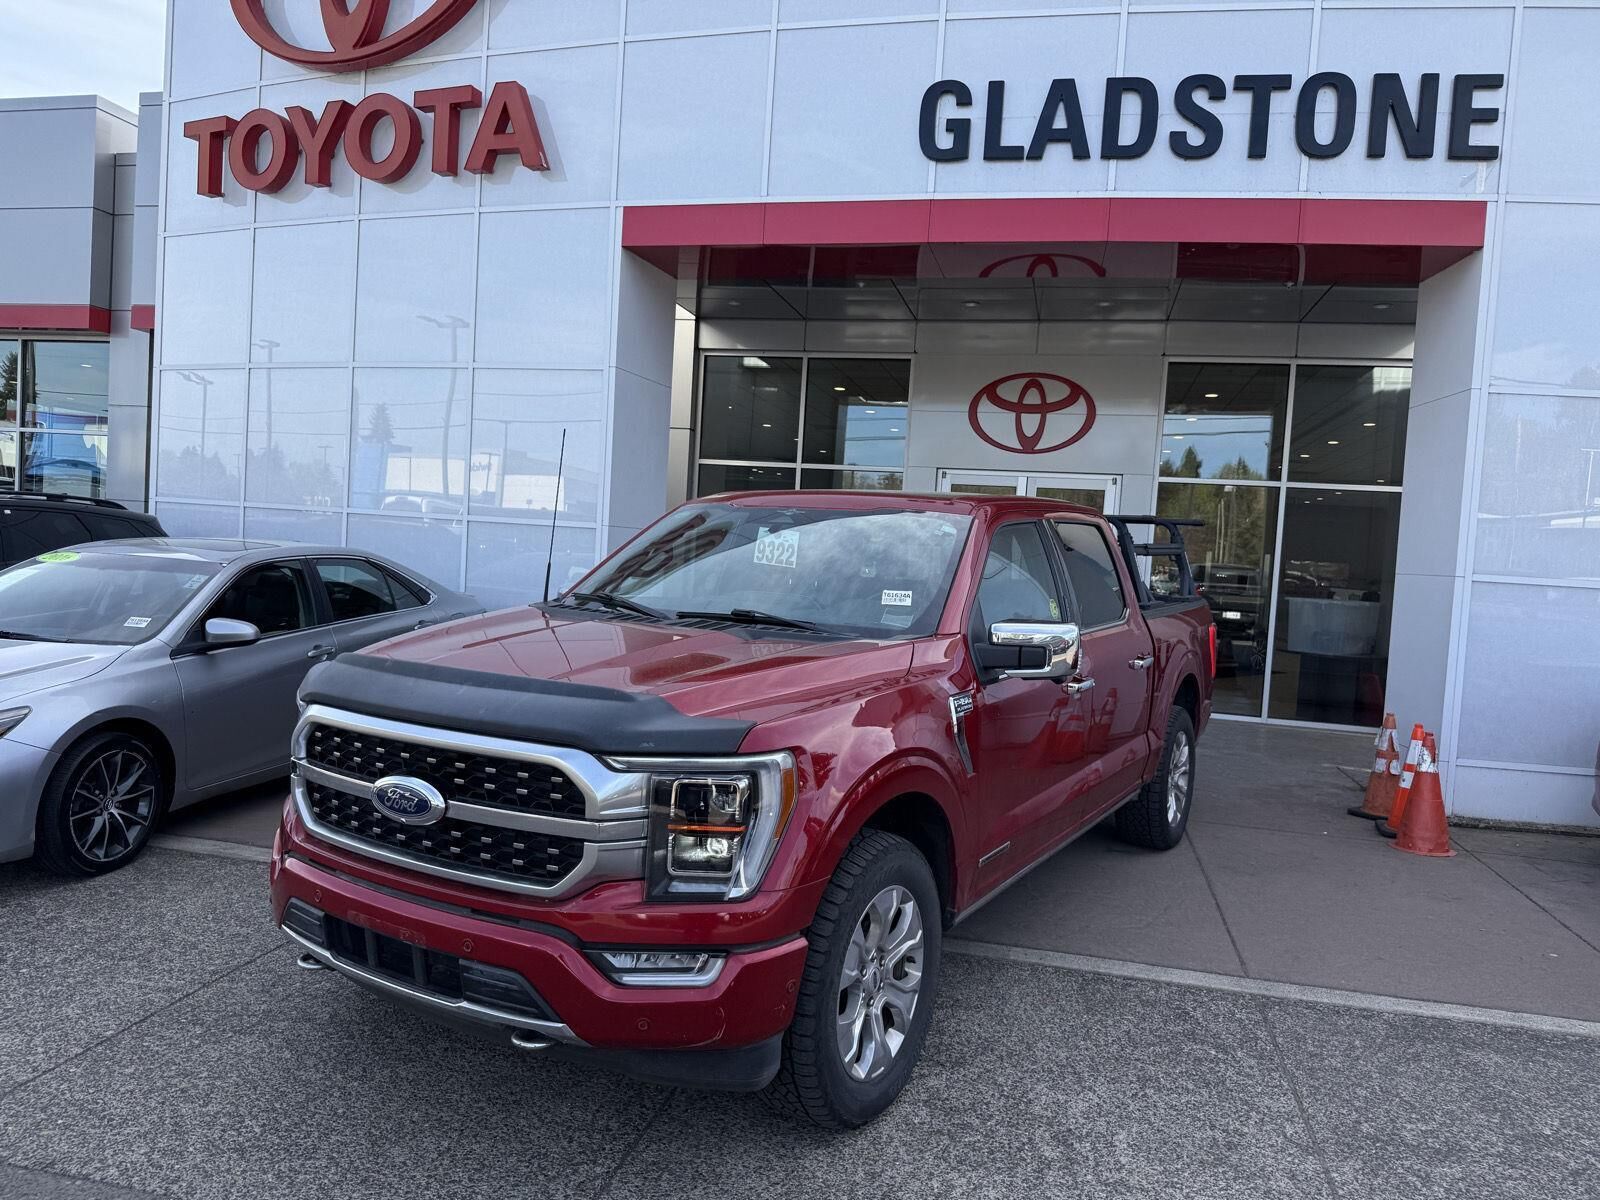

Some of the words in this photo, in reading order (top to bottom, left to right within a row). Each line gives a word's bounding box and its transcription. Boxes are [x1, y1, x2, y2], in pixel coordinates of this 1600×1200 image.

[184, 81, 550, 198] TOYOTA
[918, 72, 1505, 161] GLADSTONE
[756, 540, 795, 565] 9322
[384, 787, 419, 812] Ford
